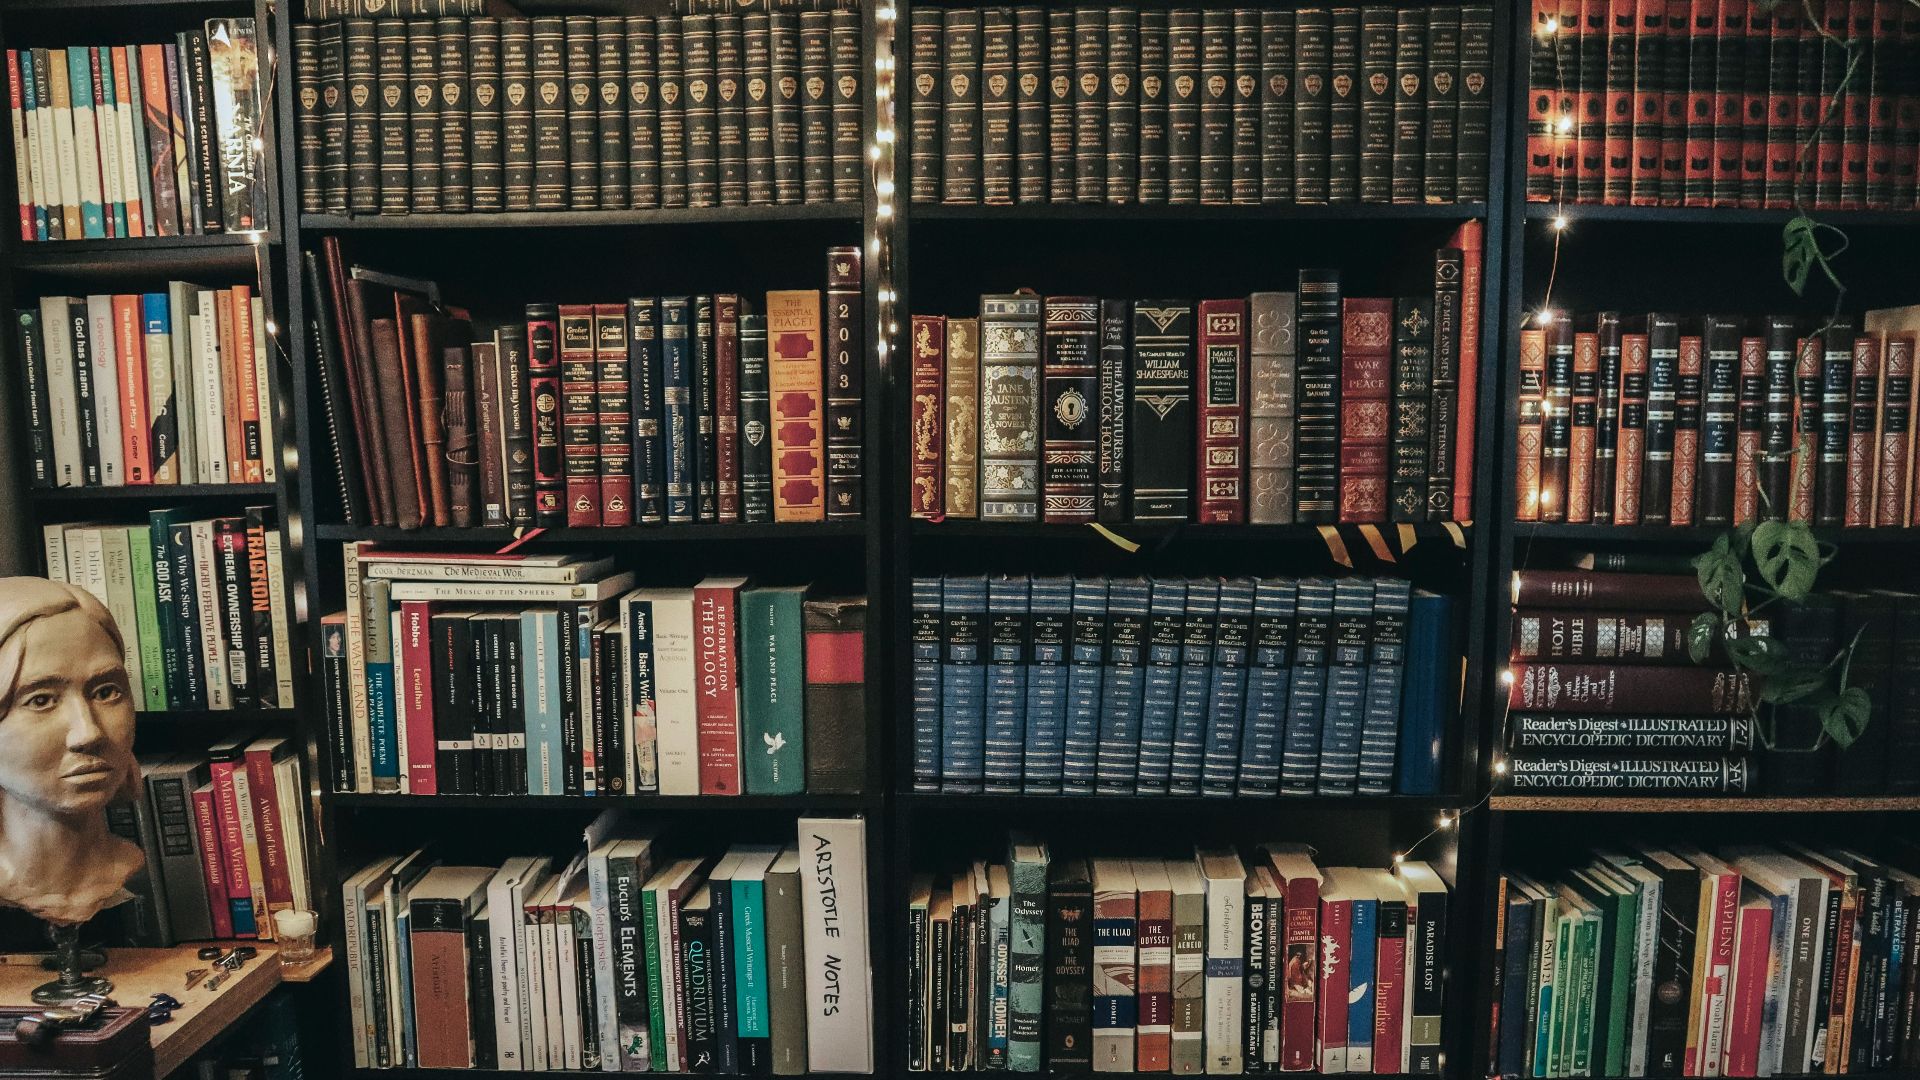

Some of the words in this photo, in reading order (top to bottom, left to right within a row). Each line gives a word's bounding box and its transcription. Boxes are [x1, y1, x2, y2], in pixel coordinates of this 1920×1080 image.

[194, 57, 203, 81] LEWIS
[244, 116, 252, 131] The
[201, 125, 210, 171] SCREWTAPE
[245, 134, 253, 171] Chronicles
[245, 172, 256, 182] of
[204, 174, 213, 208] LETTERS
[773, 309, 813, 317] ESSENTIAL
[1443, 295, 1451, 308] OF
[75, 317, 84, 337] God
[203, 302, 212, 353] SEARCHING
[240, 306, 250, 337] PREFACE
[773, 317, 814, 327] PIAGET
[1442, 309, 1450, 332] MICE
[96, 317, 107, 368] Loveology
[124, 323, 132, 355] Ruthless
[149, 320, 162, 352] LIVE
[243, 342, 251, 350] TO
[1441, 335, 1449, 355] AND
[77, 341, 85, 359] has
[151, 358, 163, 378] NO
[243, 355, 252, 389] PARADISE
[1136, 369, 1189, 379] SHAKESPEARE
[1145, 359, 1179, 369] WILLIAM
[1354, 361, 1379, 370] WAR
[1440, 358, 1448, 378] MEN
[79, 370, 89, 398] name
[127, 357, 135, 397] Elimination
[997, 384, 1024, 393] JANE
[1349, 379, 1385, 388] PEACE
[152, 385, 167, 416] LIES
[246, 394, 255, 412] LOST
[991, 395, 1029, 405] AUSTEN
[1101, 360, 1112, 423] SHERLOCK
[999, 413, 1022, 421] SEVEN
[1114, 380, 1123, 459] ADVENTURES
[1438, 395, 1448, 421] JOHN
[996, 420, 1025, 428] NOVELS
[131, 436, 139, 459] Comer
[159, 434, 167, 458] Comer
[1101, 426, 1112, 474] HOLMES
[1437, 424, 1447, 473] STEINBECK
[1114, 460, 1122, 473] OF
[157, 545, 165, 558] The
[223, 535, 234, 581] EXTREME
[89, 550, 101, 584] blink
[156, 561, 170, 581] GOD
[177, 555, 188, 576] Why
[199, 560, 211, 588] HIGHLY
[247, 525, 271, 612] TRACTION
[158, 583, 172, 602] ASK
[181, 578, 190, 592] We
[348, 567, 358, 600] ELIOT
[434, 587, 451, 596] THE
[455, 588, 482, 596] MUSIC
[499, 588, 514, 596] THE
[519, 587, 555, 596] SPHERES
[181, 594, 191, 618] Sleep
[202, 591, 214, 632] EFFECTIVE
[227, 584, 242, 649] OWNERSHIP
[350, 614, 360, 633] THE
[411, 613, 420, 647] Hobbes
[563, 612, 571, 651] AUGUSTINE
[637, 611, 646, 640] Anselm
[206, 635, 218, 663] PEOPLE
[702, 598, 717, 697] THEOLOGY
[717, 606, 727, 691] REFORMATION
[1552, 617, 1564, 657] HOLY
[1572, 618, 1584, 657] BIBLE
[352, 641, 362, 680] WASTE
[638, 652, 649, 677] Basic
[375, 673, 383, 689] THE
[414, 668, 423, 709] Leviathan
[564, 656, 572, 702] CONFESSIONS
[354, 684, 365, 718] LAND
[377, 692, 385, 735] COMPLETE
[1523, 717, 1576, 732] Reader's
[1579, 717, 1618, 736] Digest
[1628, 719, 1727, 732] ILLUSTRATED
[378, 738, 386, 764] POEMS
[1522, 734, 1631, 748] ENCYCLOPEDIC
[1637, 734, 1725, 748] DICTIONARY
[219, 768, 229, 777] A
[1514, 759, 1567, 773] Reader's
[1570, 759, 1610, 778] Digest
[1620, 760, 1719, 773] ILLUSTRATED
[1514, 776, 1623, 788] ENCYCLOPEDIC
[1629, 776, 1718, 788] DICTIONARY
[220, 780, 238, 824] Manual
[260, 797, 267, 805] A
[262, 806, 272, 832] World
[227, 827, 238, 844] for
[266, 834, 275, 843] of
[230, 847, 244, 889] Writers
[267, 845, 277, 867] Ideas
[618, 876, 632, 921] EUCLID'S
[813, 834, 840, 938] ARISTOTLE
[1014, 907, 1044, 916] Odyssey
[1719, 890, 1736, 956] SAPIENS
[999, 927, 1007, 943] THE
[1098, 928, 1111, 936] THE
[1113, 928, 1131, 936] ILIAD
[1141, 936, 1170, 945] ODYSSEY
[1250, 904, 1264, 969] BEOWULF
[1801, 918, 1811, 938] ONE
[1178, 940, 1202, 949] AENEID
[1426, 921, 1435, 966] PARADISE
[1799, 941, 1810, 962] LIFE
[621, 927, 637, 997] ELEMENTS
[996, 944, 1007, 987] ODYSSEY
[688, 941, 708, 1042] QUADRIVIUM
[824, 955, 841, 1017] NOTES
[1424, 969, 1433, 992] LOST
[995, 998, 1006, 1038] HOMER
[1376, 981, 1392, 1034] Paradise
